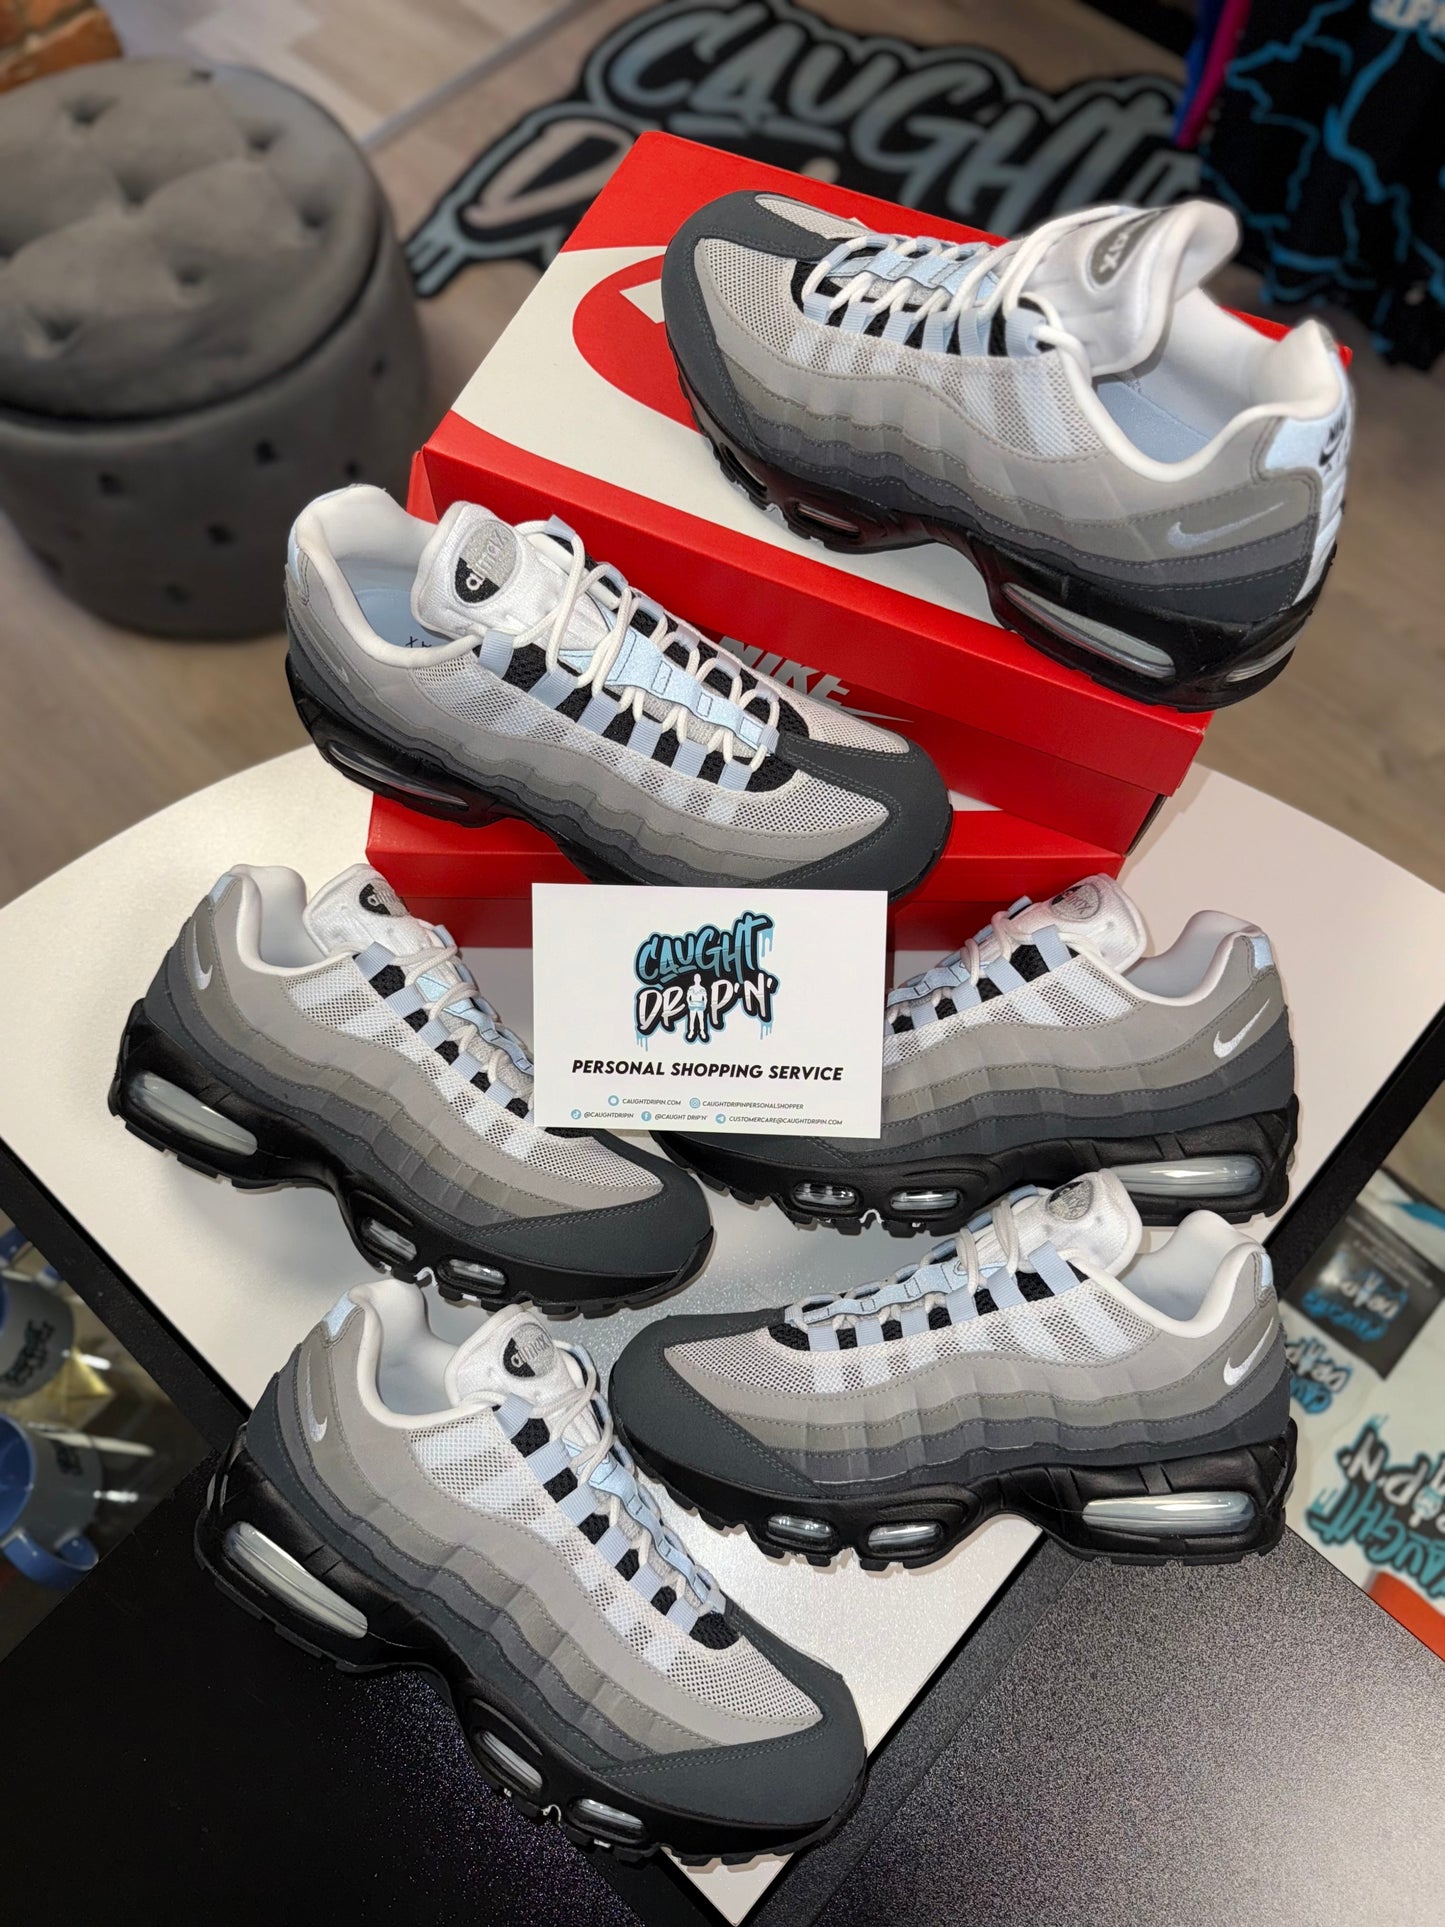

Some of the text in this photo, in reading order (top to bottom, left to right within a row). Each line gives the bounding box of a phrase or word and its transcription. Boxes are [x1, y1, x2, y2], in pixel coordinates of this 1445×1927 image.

[598, 5, 1177, 238] CAUGHT
[636, 912, 772, 984] CAUGHT
[572, 1059, 844, 1081] PERSONAL SHOPPING SERVICE
[621, 1098, 682, 1106] CAUGHTDRIPIN.COM
[702, 1100, 804, 1110] CAUGHTDRIPINPERSONALSHOPPER
[583, 1111, 634, 1119] @CAUGHTDRIPIN
[728, 1115, 843, 1126] CUSTOMERCARE@CAUGHTDRIPIN.COM
